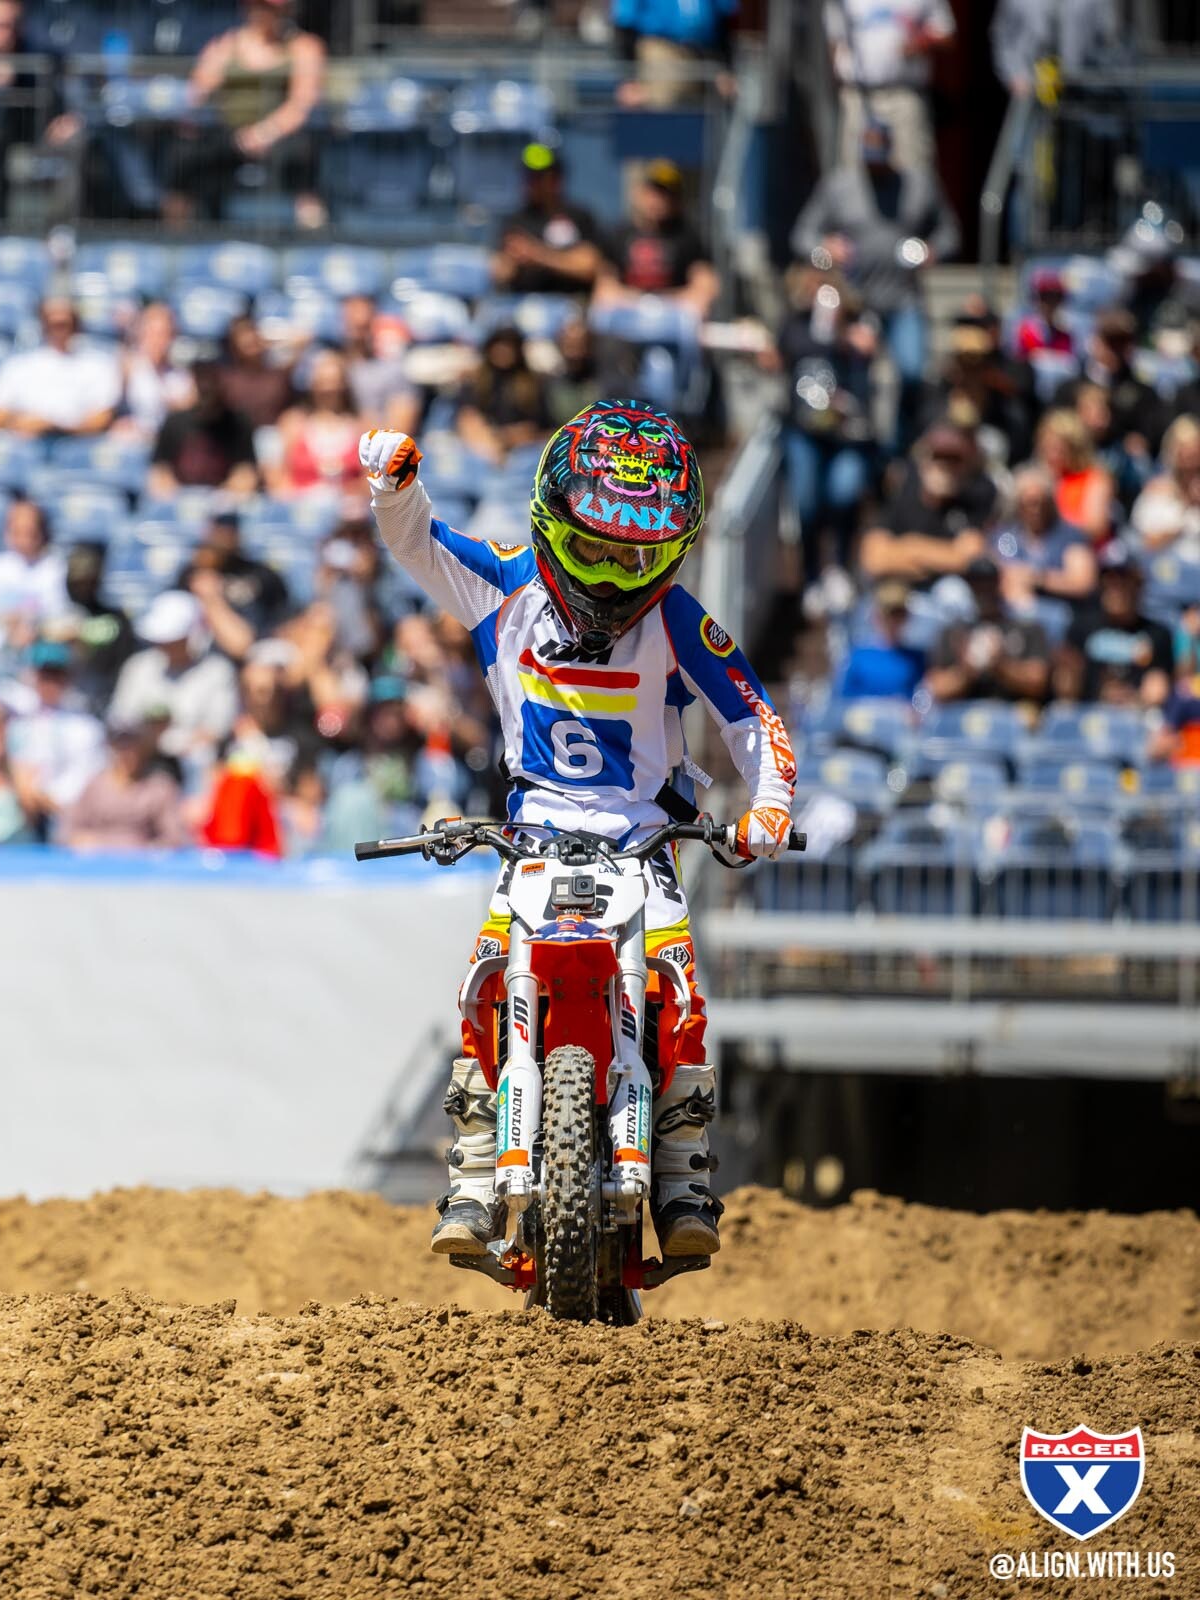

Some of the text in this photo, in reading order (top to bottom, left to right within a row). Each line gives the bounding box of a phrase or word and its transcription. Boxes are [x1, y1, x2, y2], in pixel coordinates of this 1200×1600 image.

[575, 492, 680, 531] LYNX
[550, 720, 604, 779] 6
[514, 995, 529, 1043] WP
[621, 992, 637, 1042] WP
[511, 1086, 523, 1147] DUNLOP
[626, 1084, 638, 1147] DUNLOP
[640, 1087, 651, 1139] MOTOREX
